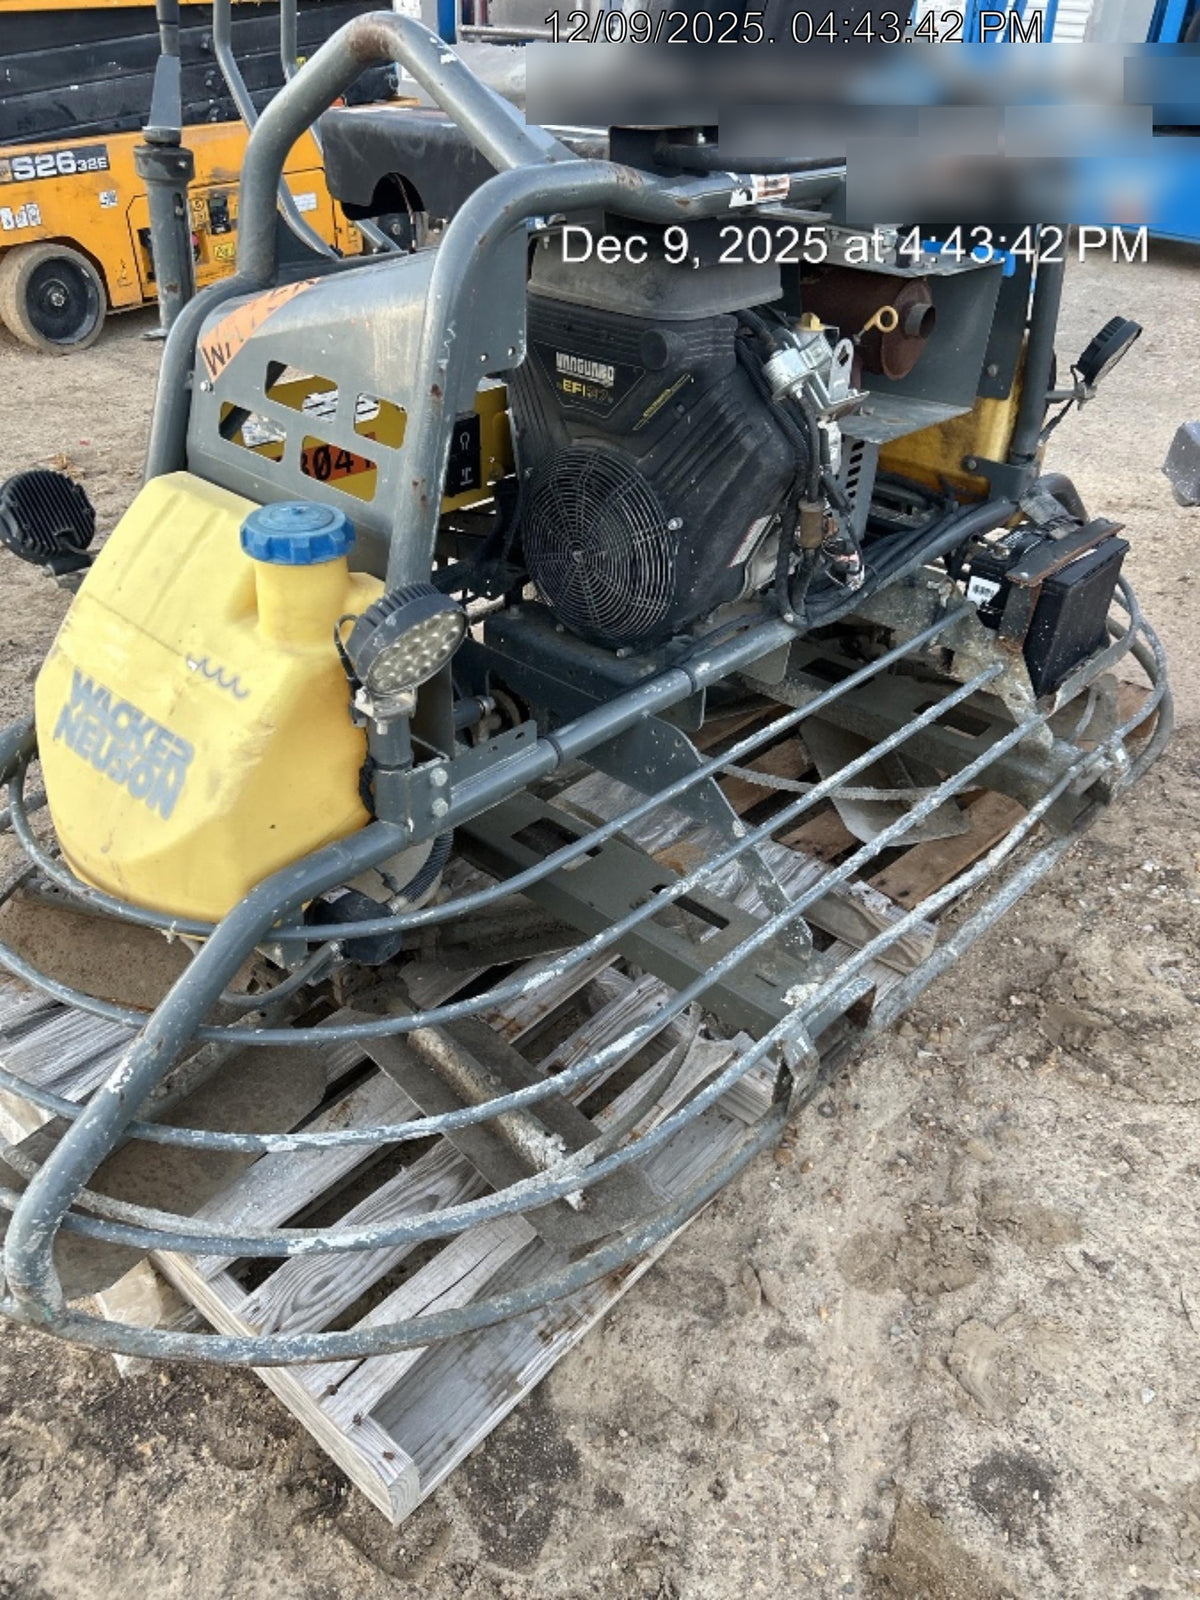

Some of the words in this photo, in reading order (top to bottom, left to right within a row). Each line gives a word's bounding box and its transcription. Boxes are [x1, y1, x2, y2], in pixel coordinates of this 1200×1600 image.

[556, 351, 615, 382] VANGUARD
[53, 703, 188, 821] NEUSON
[70, 666, 195, 767] WACKER
